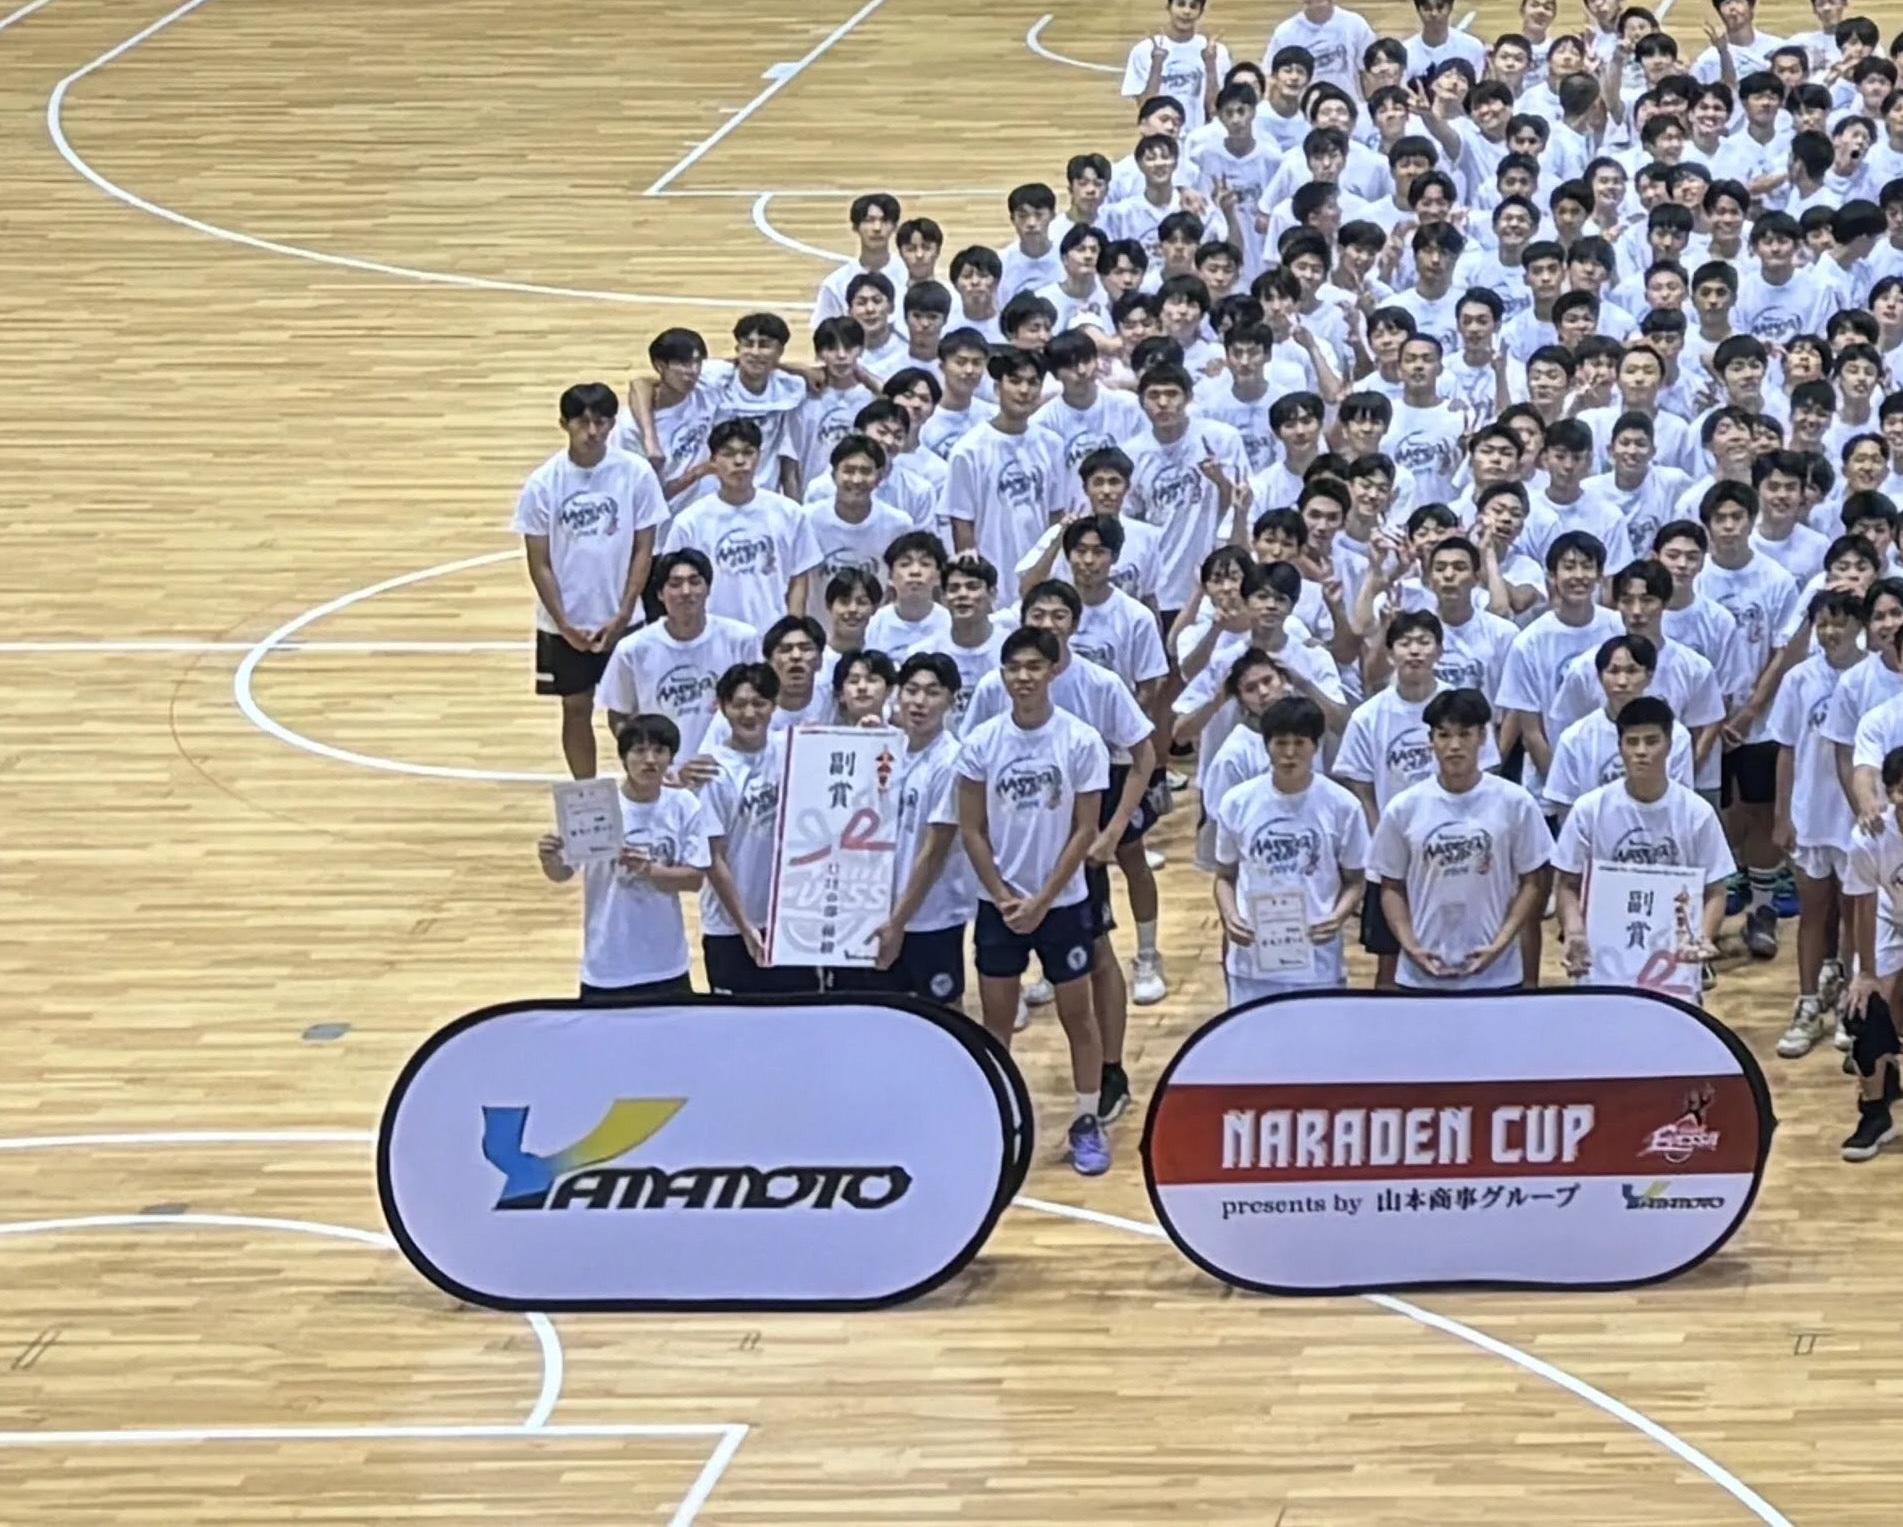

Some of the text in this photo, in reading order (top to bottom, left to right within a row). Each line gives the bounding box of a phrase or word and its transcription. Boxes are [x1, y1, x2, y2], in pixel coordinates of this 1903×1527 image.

[828, 750, 856, 809] 副賞
[1626, 889, 1655, 949] 副賞
[481, 1097, 913, 1211] YAMAMOTO
[1222, 1105, 1595, 1169] NARADEN CUP
[1222, 1194, 1363, 1220] presents by
[1376, 1182, 1582, 1214] 山本商事グループ
